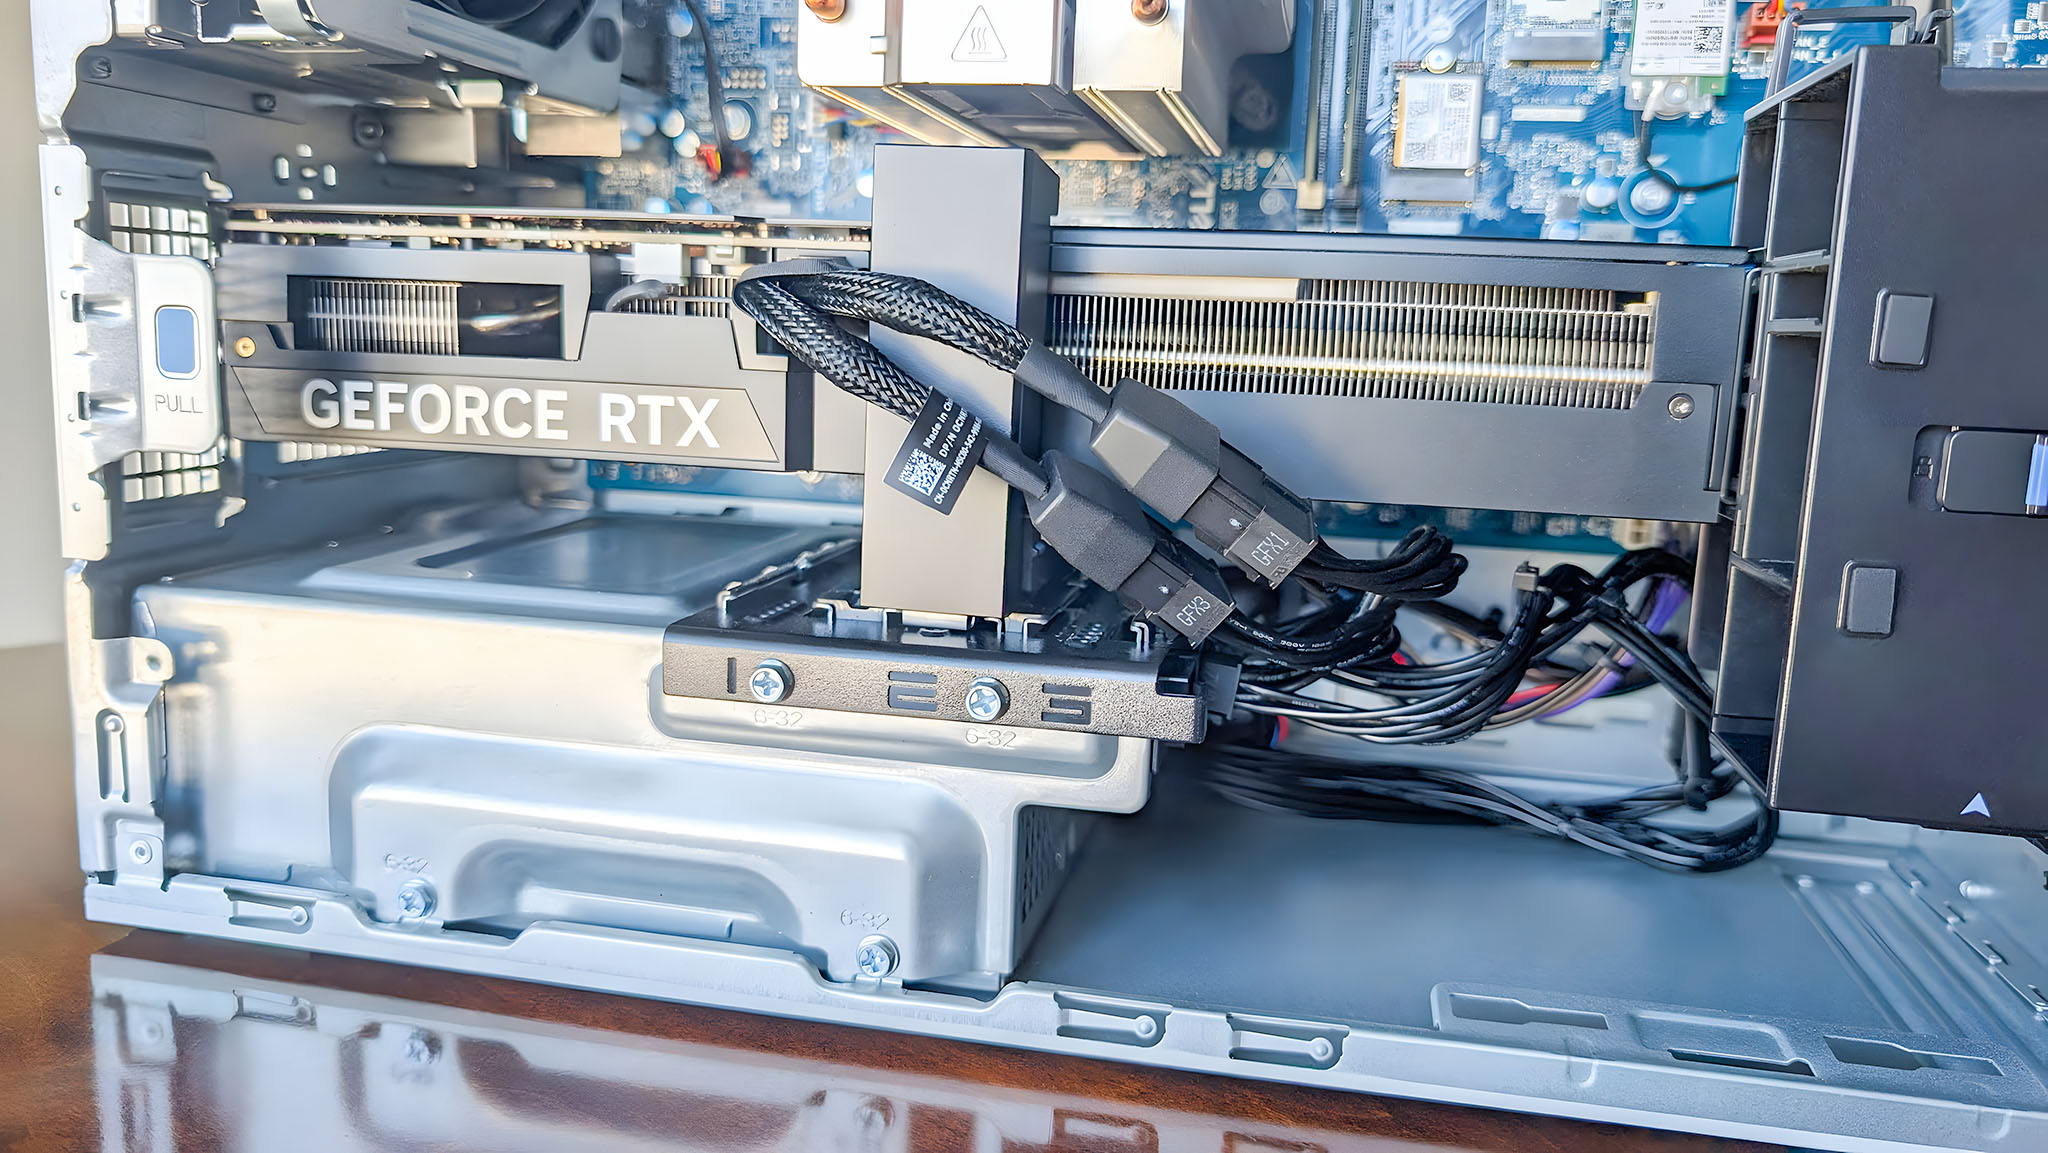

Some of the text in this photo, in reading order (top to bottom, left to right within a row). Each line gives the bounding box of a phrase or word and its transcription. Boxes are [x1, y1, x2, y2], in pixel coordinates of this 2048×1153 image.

[155, 394, 204, 414] PULL
[302, 377, 721, 449] GEFORCE RTX
[922, 421, 943, 449] Made
[938, 432, 958, 458] DP/N
[1251, 531, 1290, 567] GFX1
[1176, 595, 1211, 627] GFX3
[888, 671, 938, 712] 2
[754, 707, 804, 728] 6-32
[966, 728, 1017, 748] 6-32
[840, 908, 889, 931] 6-32
